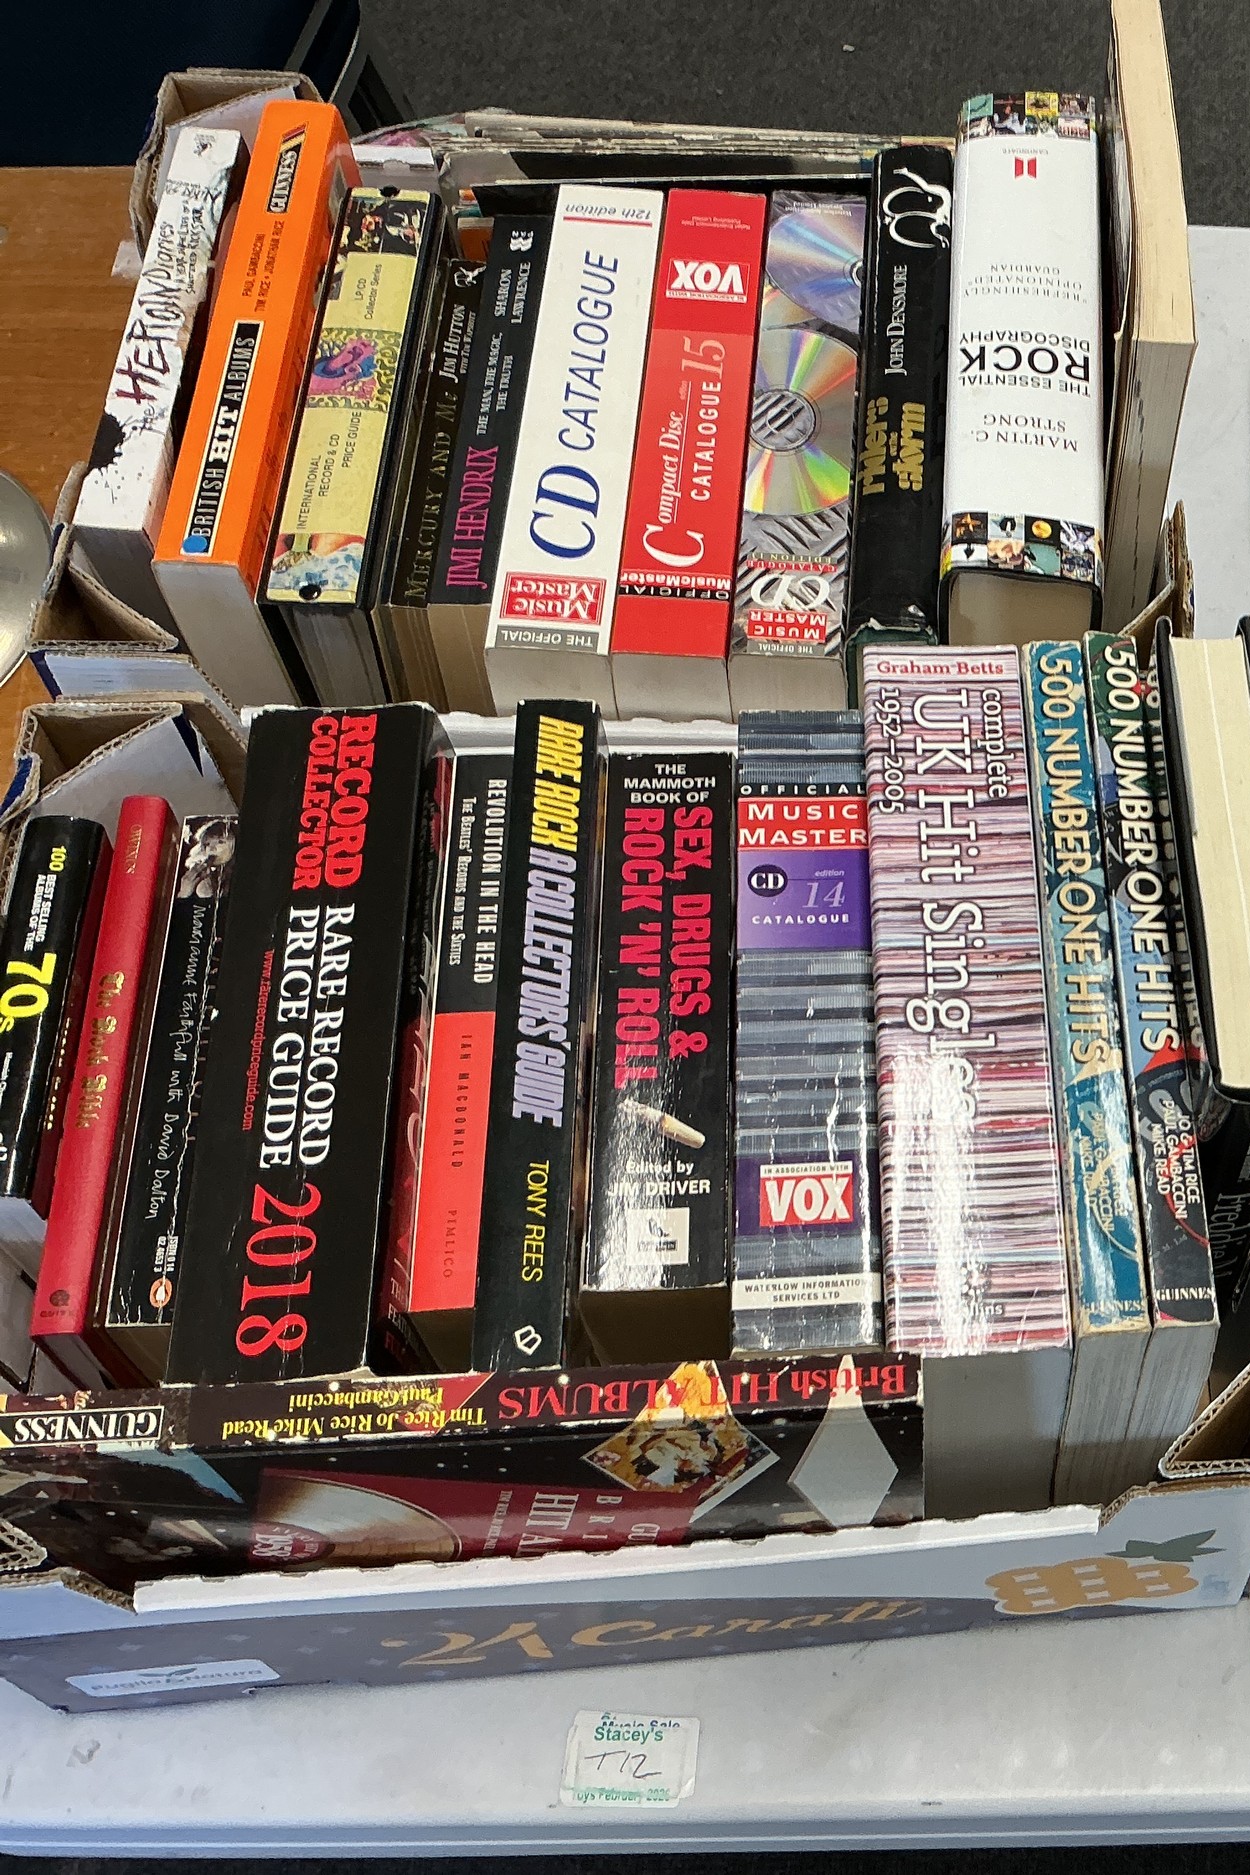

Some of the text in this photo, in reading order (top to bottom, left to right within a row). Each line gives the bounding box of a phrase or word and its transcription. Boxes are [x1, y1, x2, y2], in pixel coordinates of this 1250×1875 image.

[267, 149, 298, 213] GUINNESS
[565, 203, 651, 220] 12th edition
[365, 263, 383, 321] Collector Series
[495, 268, 513, 317] SHARON
[511, 261, 531, 324] LAWRENCE
[670, 260, 744, 293] VOX
[990, 263, 1060, 275] GUARDIAN
[439, 304, 466, 384] JIM HUTTON
[885, 265, 908, 375] JOHN DENSMORE
[960, 331, 1090, 353] DISCOGRAPHY
[496, 355, 513, 411] THE TRUTH
[960, 345, 1090, 383] ROCK
[960, 375, 1090, 397] THE ESSENTIAL
[530, 250, 619, 560] CD CATALOGUE
[983, 413, 1066, 432] STRONG
[191, 337, 255, 537] BRITISH HIT ALBUMS
[342, 410, 363, 469] PRICE GUIDE
[690, 381, 721, 502] CATALOGUE
[859, 396, 888, 494] riders
[297, 455, 322, 530] INTERNATIONAL
[446, 446, 498, 591] JIMI HENDRIX
[511, 580, 596, 601] Master
[621, 586, 729, 600] OFFICIAL
[747, 560, 835, 572] CATALOGUE
[750, 574, 830, 609] CD
[515, 598, 588, 619] Music
[750, 611, 826, 626] MASTER
[754, 625, 819, 639] MUSIC
[501, 630, 594, 649] THE OFFICIAL
[877, 661, 1003, 675] Graham Betts
[536, 715, 584, 783] RARE
[654, 764, 686, 775] THE
[976, 688, 1007, 798] complete
[292, 716, 338, 892] COLLECTOR
[326, 712, 378, 888] RECORD
[624, 776, 716, 790] MAMMOTH
[630, 790, 709, 804] BOOK OF
[740, 784, 864, 795] OFFICIAL
[531, 779, 580, 852] ROCK
[739, 827, 867, 845] MASTER
[747, 802, 859, 821] MUSIC
[529, 846, 576, 872] A
[1039, 654, 1110, 1064] 500 NUMBER ONE HITS
[1104, 644, 1181, 1053] 500 NUMBER ONE HITS
[36, 845, 67, 942] 100 BEST SELLING
[474, 779, 508, 984] REVOLUTION IN THE HEAD
[750, 868, 845, 890] CD edition
[802, 881, 845, 908] 14
[905, 689, 996, 1119] UK Hit Singles
[669, 806, 713, 1059] SEX, DRUGS &
[751, 914, 849, 924] CATALOGUE
[615, 807, 665, 1089] ROCK 'N' ROLL
[144, 905, 207, 1220] Marianne Faithfull with David Dalton
[241, 948, 276, 1132] www.rarerecordpriceguide.com
[259, 906, 321, 1171] PRICE GUIDE
[297, 903, 355, 1167] RARE RECORD
[452, 1035, 472, 1168] IAN MACDONALD
[512, 1041, 568, 1127] GUIDE
[626, 1161, 694, 1175] Edited by
[1151, 1123, 1171, 1195] MIKE READ
[1162, 1099, 1188, 1219] PAUL GAMBACCINI
[1178, 1115, 1200, 1204] JO & TIM RICE
[608, 1179, 710, 1196] JIM DRIVER
[765, 1177, 850, 1223] VOX
[444, 1209, 457, 1279] PIMLICO
[522, 1160, 549, 1282] TONY REES
[234, 1182, 323, 1356] 2018
[773, 1291, 840, 1302] SERVICES LTD
[289, 1387, 443, 1412] Paul Gambaccini
[498, 1363, 906, 1419] British HIT ALBUMS
[14, 1411, 157, 1442] GUINNESS
[222, 1406, 486, 1439] Tim Rice Jo Rice Mike Read
[594, 1726, 664, 1744] Stacey's
[585, 1750, 662, 1778] T12
